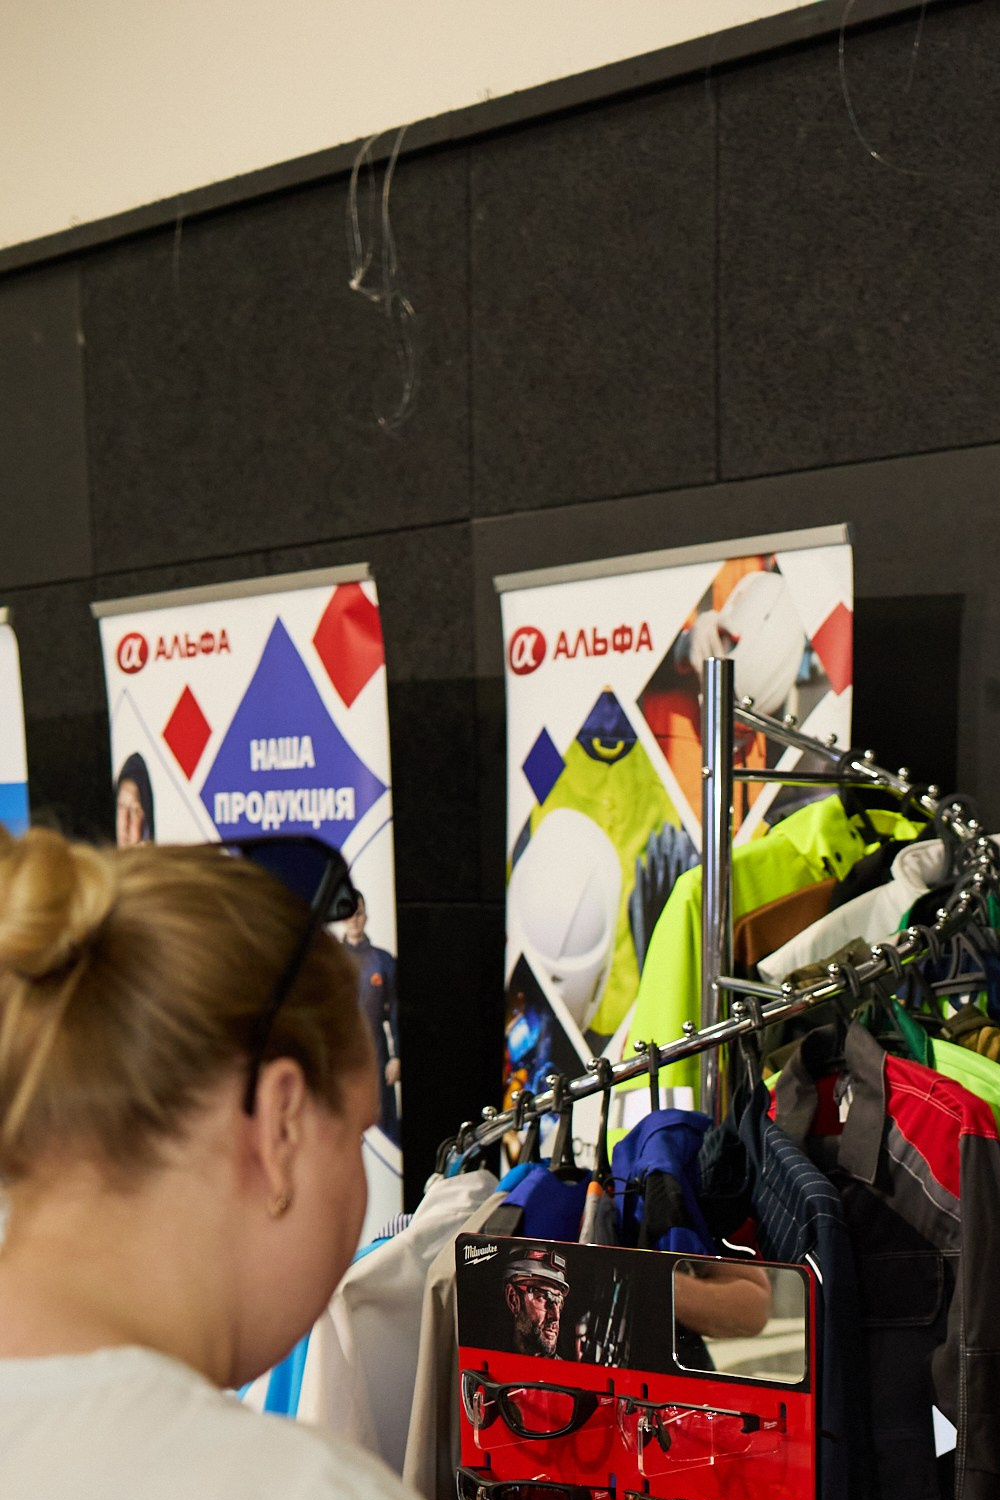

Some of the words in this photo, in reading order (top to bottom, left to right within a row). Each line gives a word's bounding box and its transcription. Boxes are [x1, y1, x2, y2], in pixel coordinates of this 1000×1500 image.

[155, 629, 231, 661] АЛЬФА
[553, 621, 653, 660] АЛЬФА
[250, 735, 316, 772] НАША
[213, 786, 355, 831] ПРОДУКЦИЯ
[463, 1243, 498, 1260] Milwaukee
